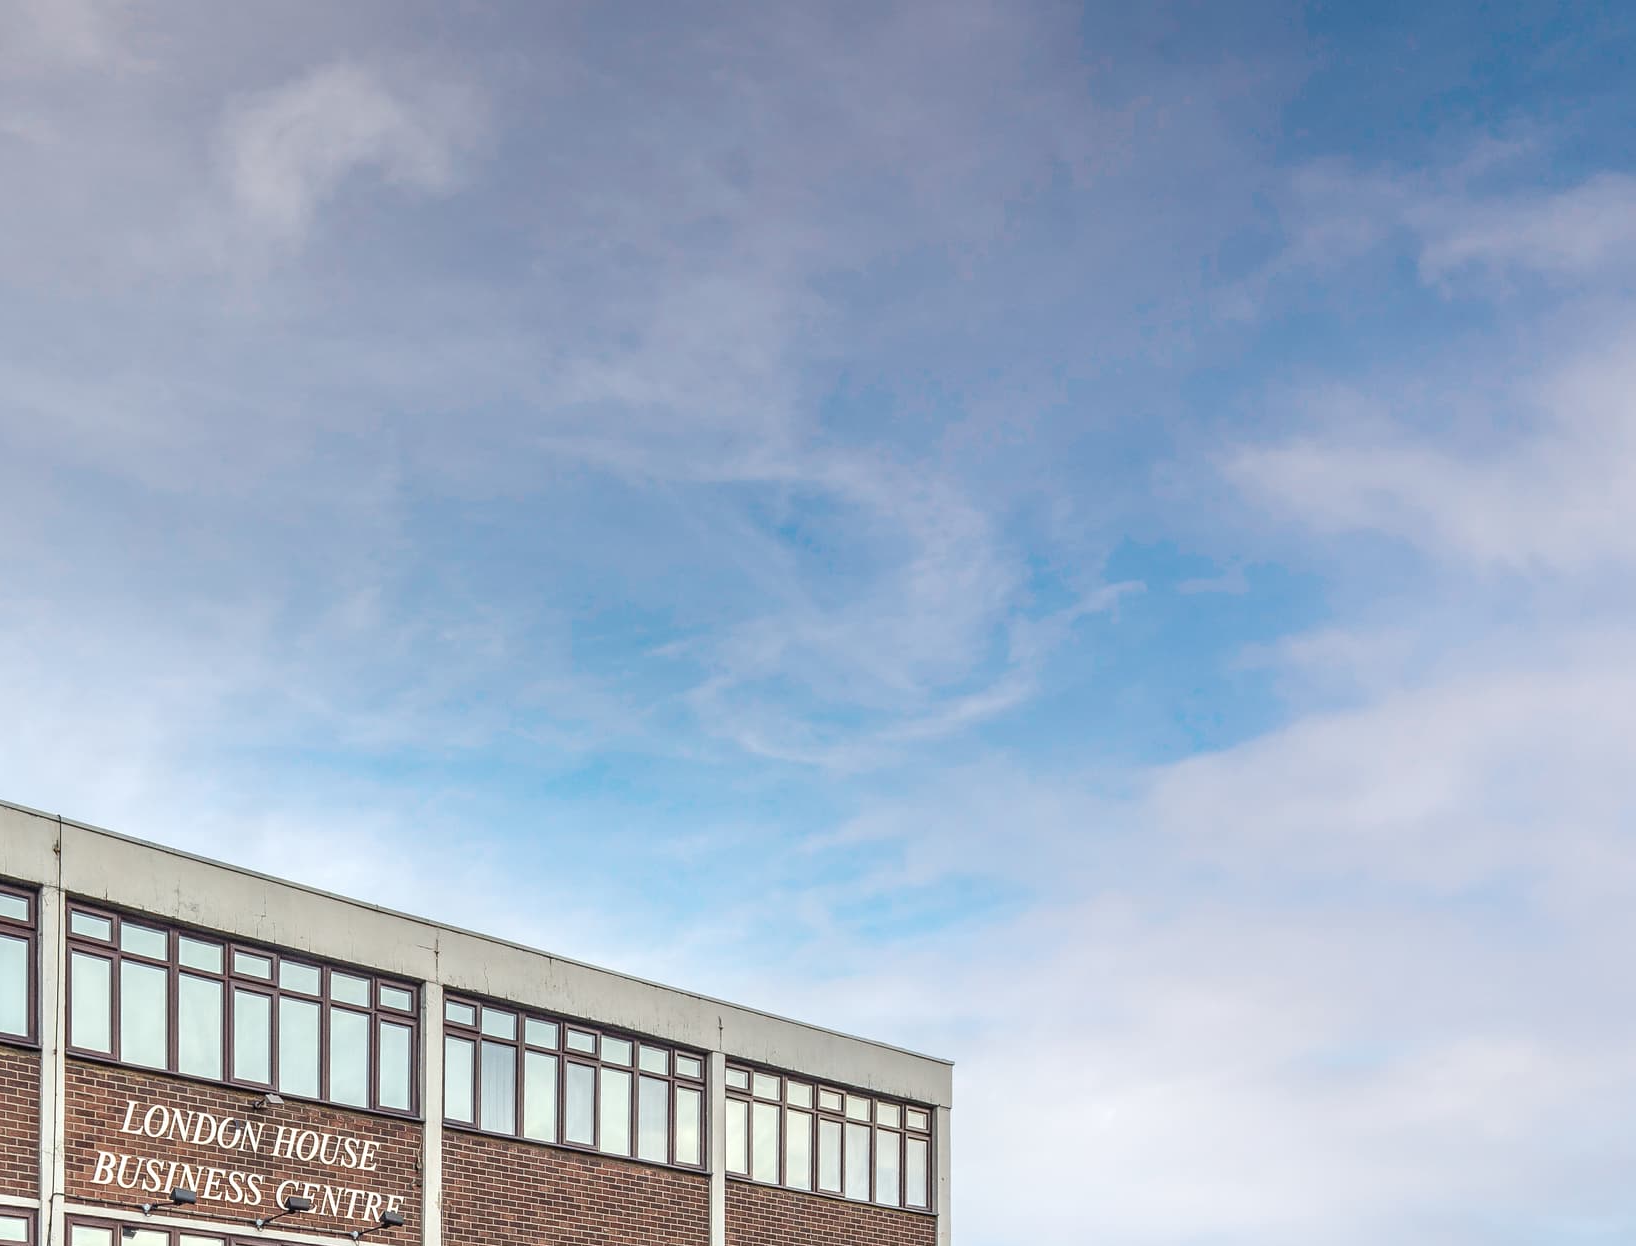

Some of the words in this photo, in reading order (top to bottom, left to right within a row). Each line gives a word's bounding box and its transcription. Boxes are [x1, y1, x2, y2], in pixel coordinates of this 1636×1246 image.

[119, 1100, 264, 1153] LONDON
[271, 1125, 381, 1172] HOUSE
[90, 1150, 265, 1207] BUSINESS
